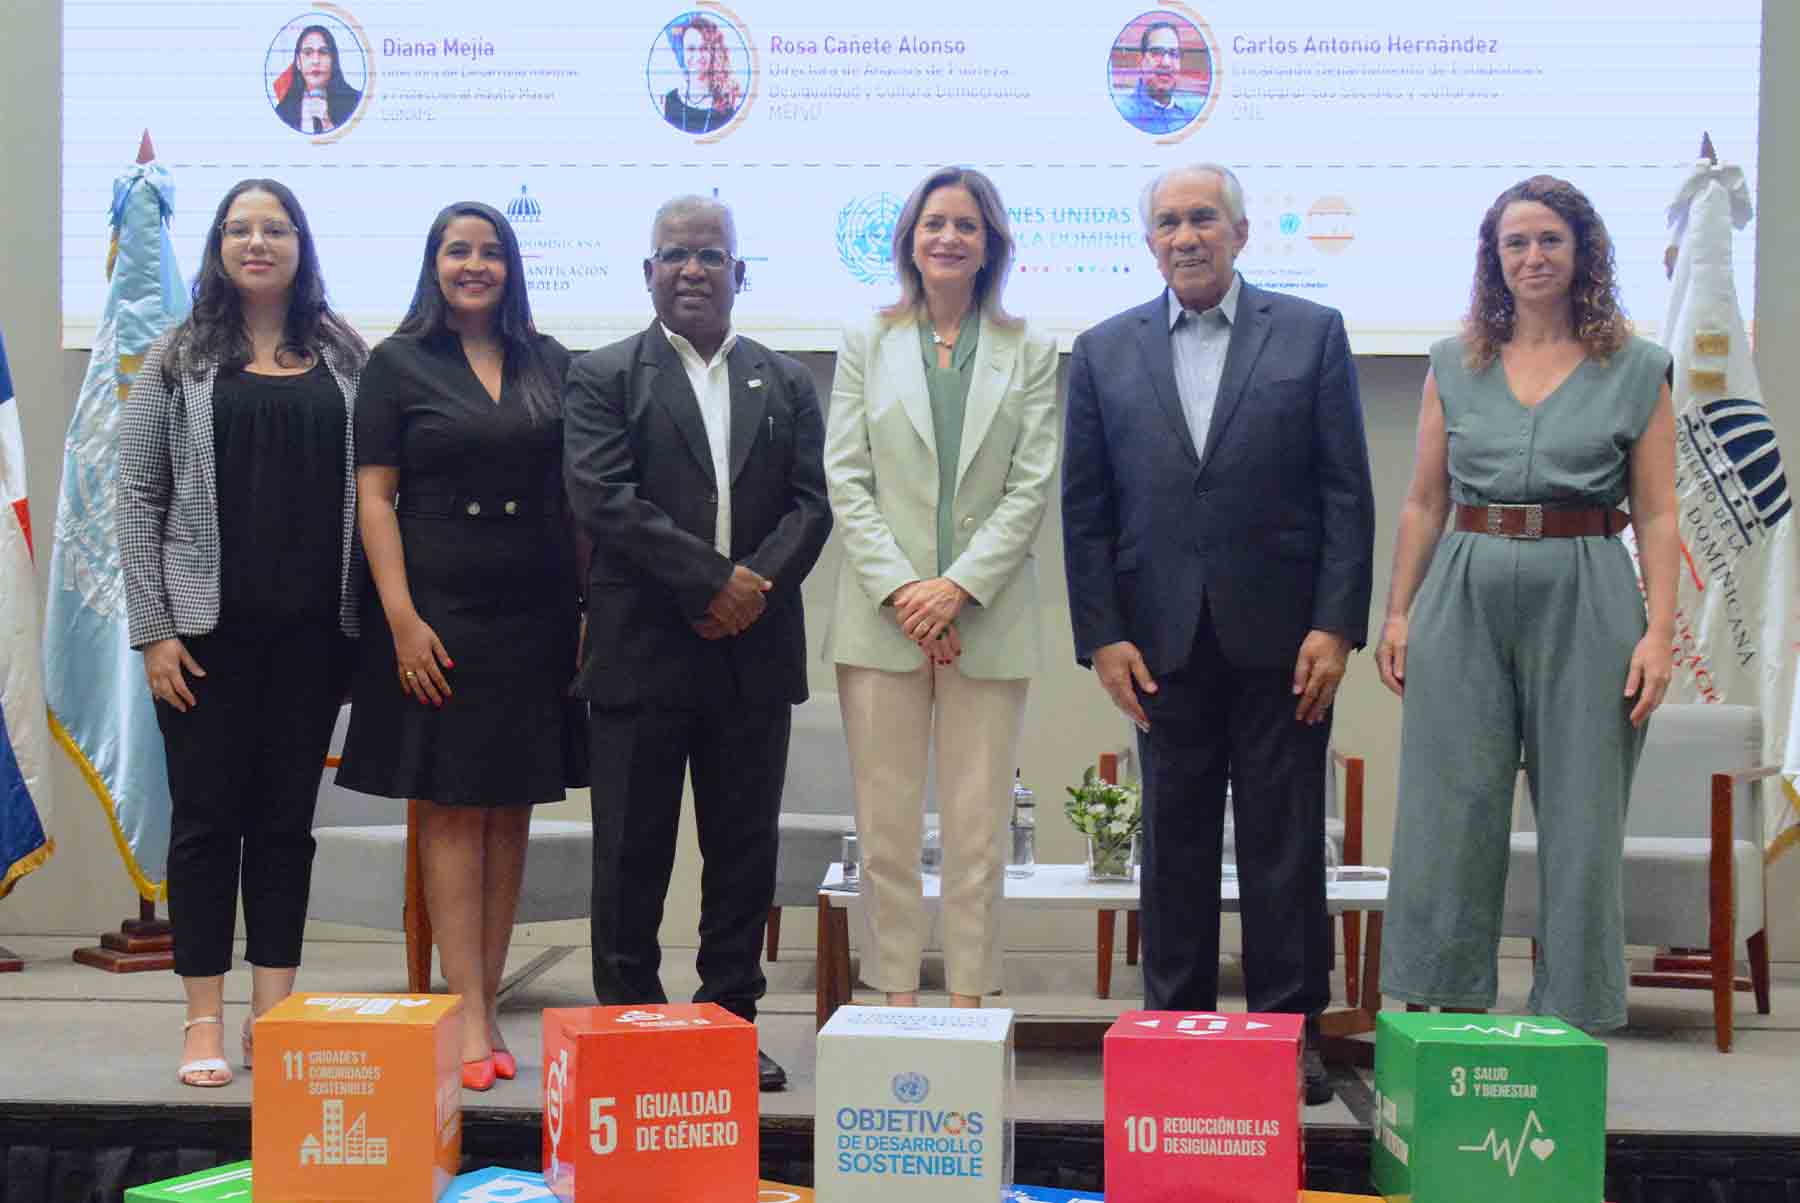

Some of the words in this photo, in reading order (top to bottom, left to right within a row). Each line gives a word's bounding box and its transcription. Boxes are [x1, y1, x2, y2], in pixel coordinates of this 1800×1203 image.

[383, 37, 437, 57] Diana
[770, 35, 817, 55] Rosa
[824, 32, 892, 55] Cañete
[898, 34, 967, 55] Alonso
[1232, 34, 1298, 55] Carlos
[1303, 34, 1382, 55] Antonio
[1387, 33, 1499, 55] Hernández
[1052, 207, 1132, 223] UNIDAS
[283, 1050, 304, 1081] 11
[1473, 1066, 1510, 1081] SALUD
[1451, 1066, 1466, 1097] 3
[636, 1089, 732, 1119] IGUALDAD
[589, 1097, 619, 1156] 5
[836, 1107, 985, 1135] OBJETIVOS
[1163, 1115, 1235, 1136] REDUCCIÓN
[1237, 1119, 1253, 1136] DE
[1255, 1119, 1281, 1137] LAS
[636, 1126, 661, 1152] DE
[664, 1119, 739, 1150] GÉNERO
[837, 1135, 863, 1151] DE
[865, 1136, 984, 1154] DESARROLLO
[1124, 1116, 1158, 1153] 10
[1163, 1137, 1267, 1157] DESIGUALDADES
[837, 1152, 984, 1178] SOSTENIBLE
